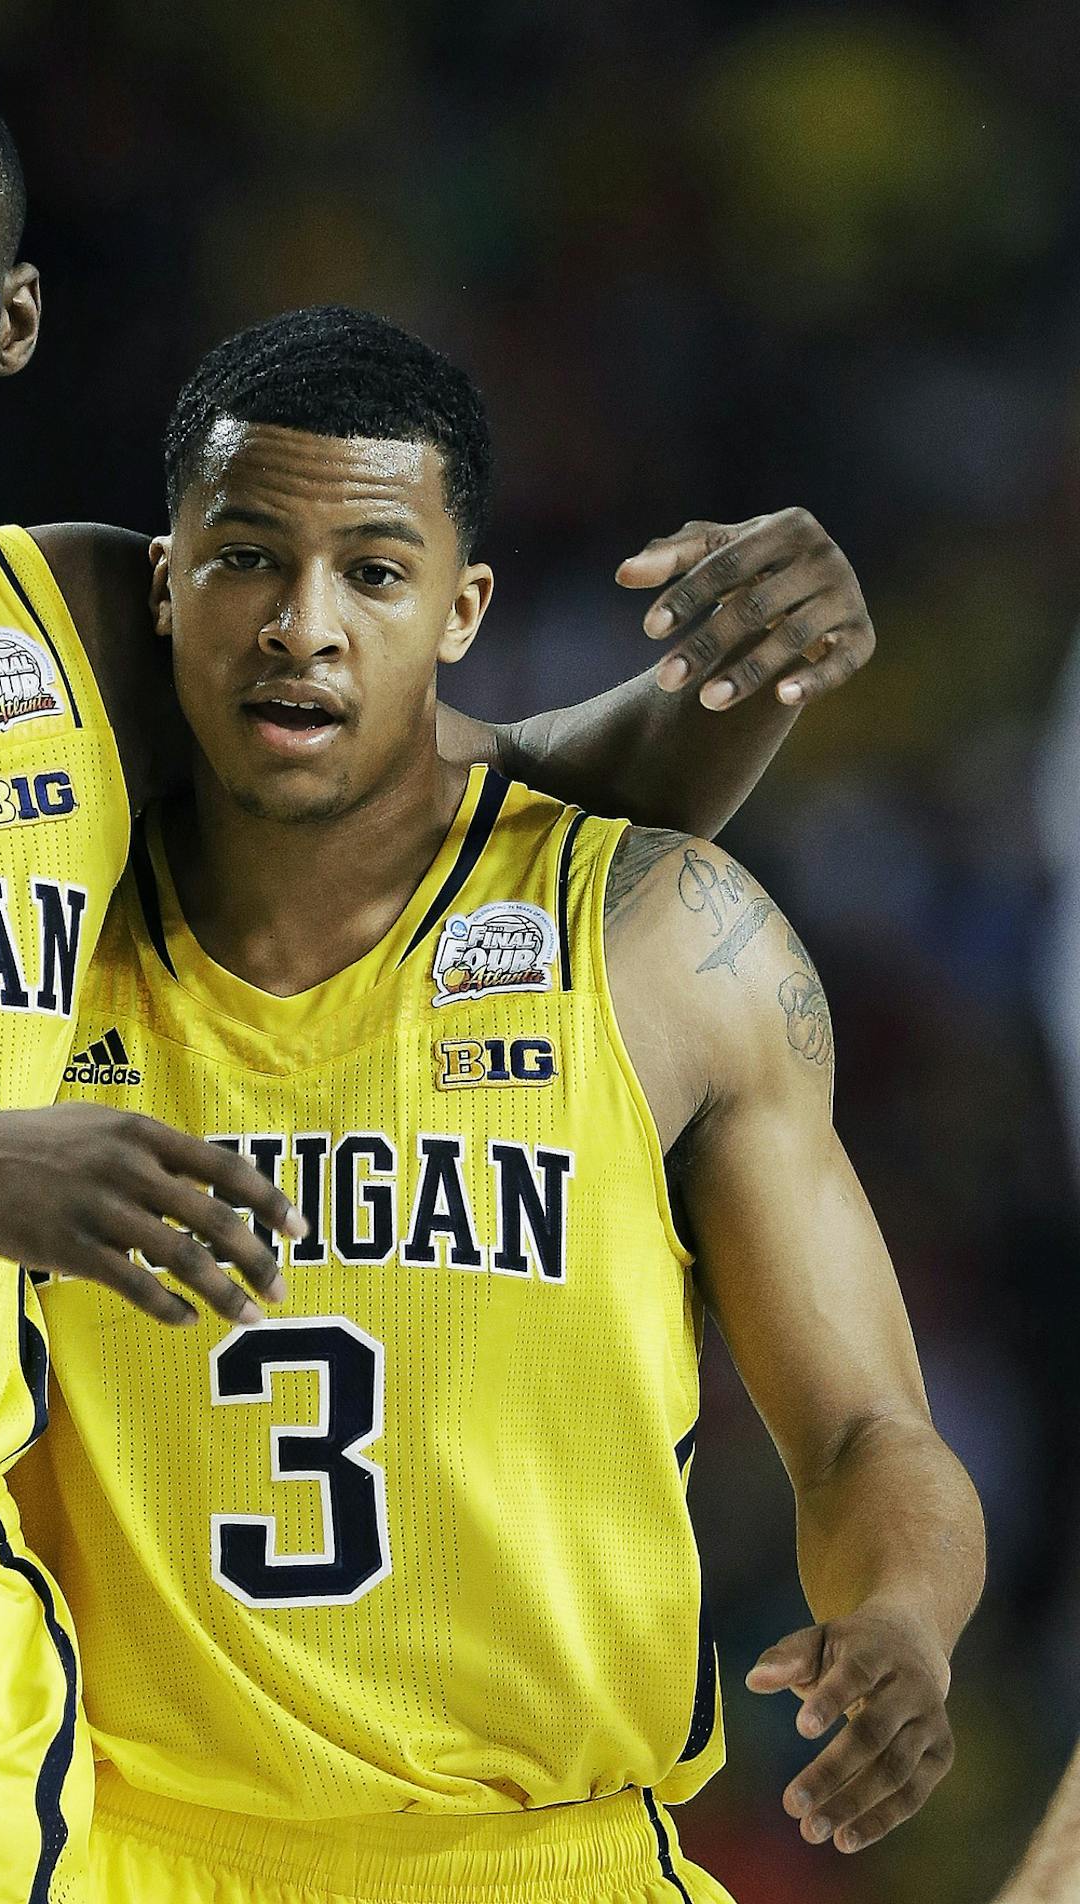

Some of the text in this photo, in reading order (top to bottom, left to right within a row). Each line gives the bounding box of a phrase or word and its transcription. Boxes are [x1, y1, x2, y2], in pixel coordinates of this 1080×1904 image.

[468, 925, 536, 948] FINAL
[438, 938, 536, 973] FOUR
[460, 965, 545, 990] Atlanta
[62, 1063, 141, 1085] adidas
[28, 1132, 574, 1286] IGAN
[209, 1316, 392, 1608] 3
